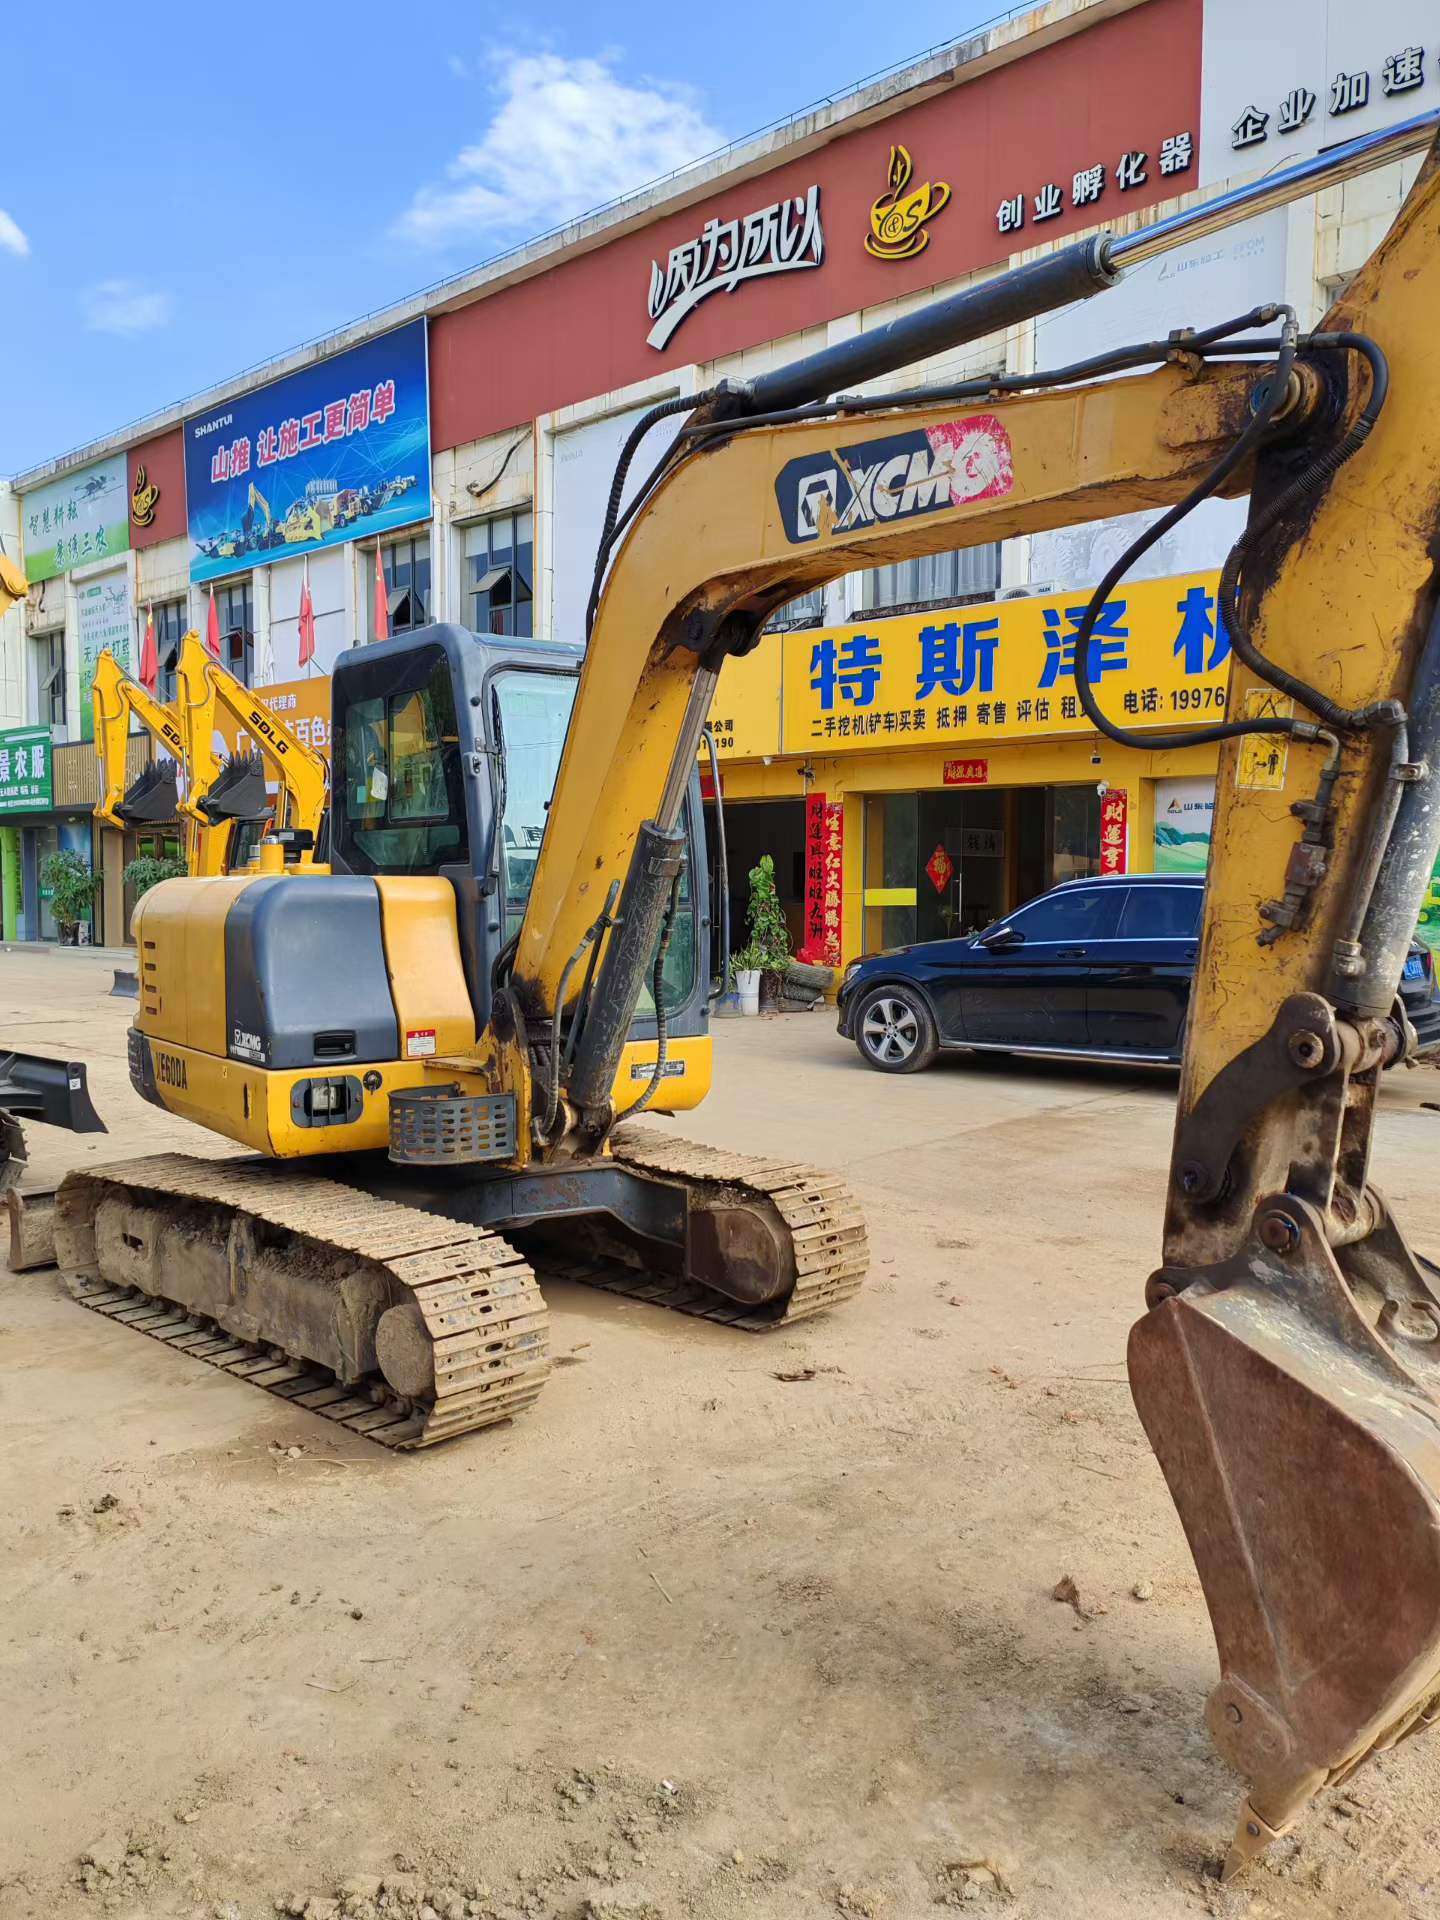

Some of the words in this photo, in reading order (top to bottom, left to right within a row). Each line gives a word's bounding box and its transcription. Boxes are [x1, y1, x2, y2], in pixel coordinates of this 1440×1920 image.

[1231, 46, 1440, 149] 企业加速
[996, 131, 1193, 233] 创业孵化器
[194, 414, 233, 438] SHANTUI
[210, 436, 250, 483] 山推
[257, 380, 396, 468] 让施工更简单
[838, 431, 1001, 529] XCMG
[160, 723, 186, 750] SD
[249, 711, 289, 754] SDLG
[811, 708, 926, 738] 二手挖机(铲车)买卖
[937, 704, 968, 728] 抵押
[976, 700, 1007, 725] 寄售
[1016, 697, 1050, 722] 评估
